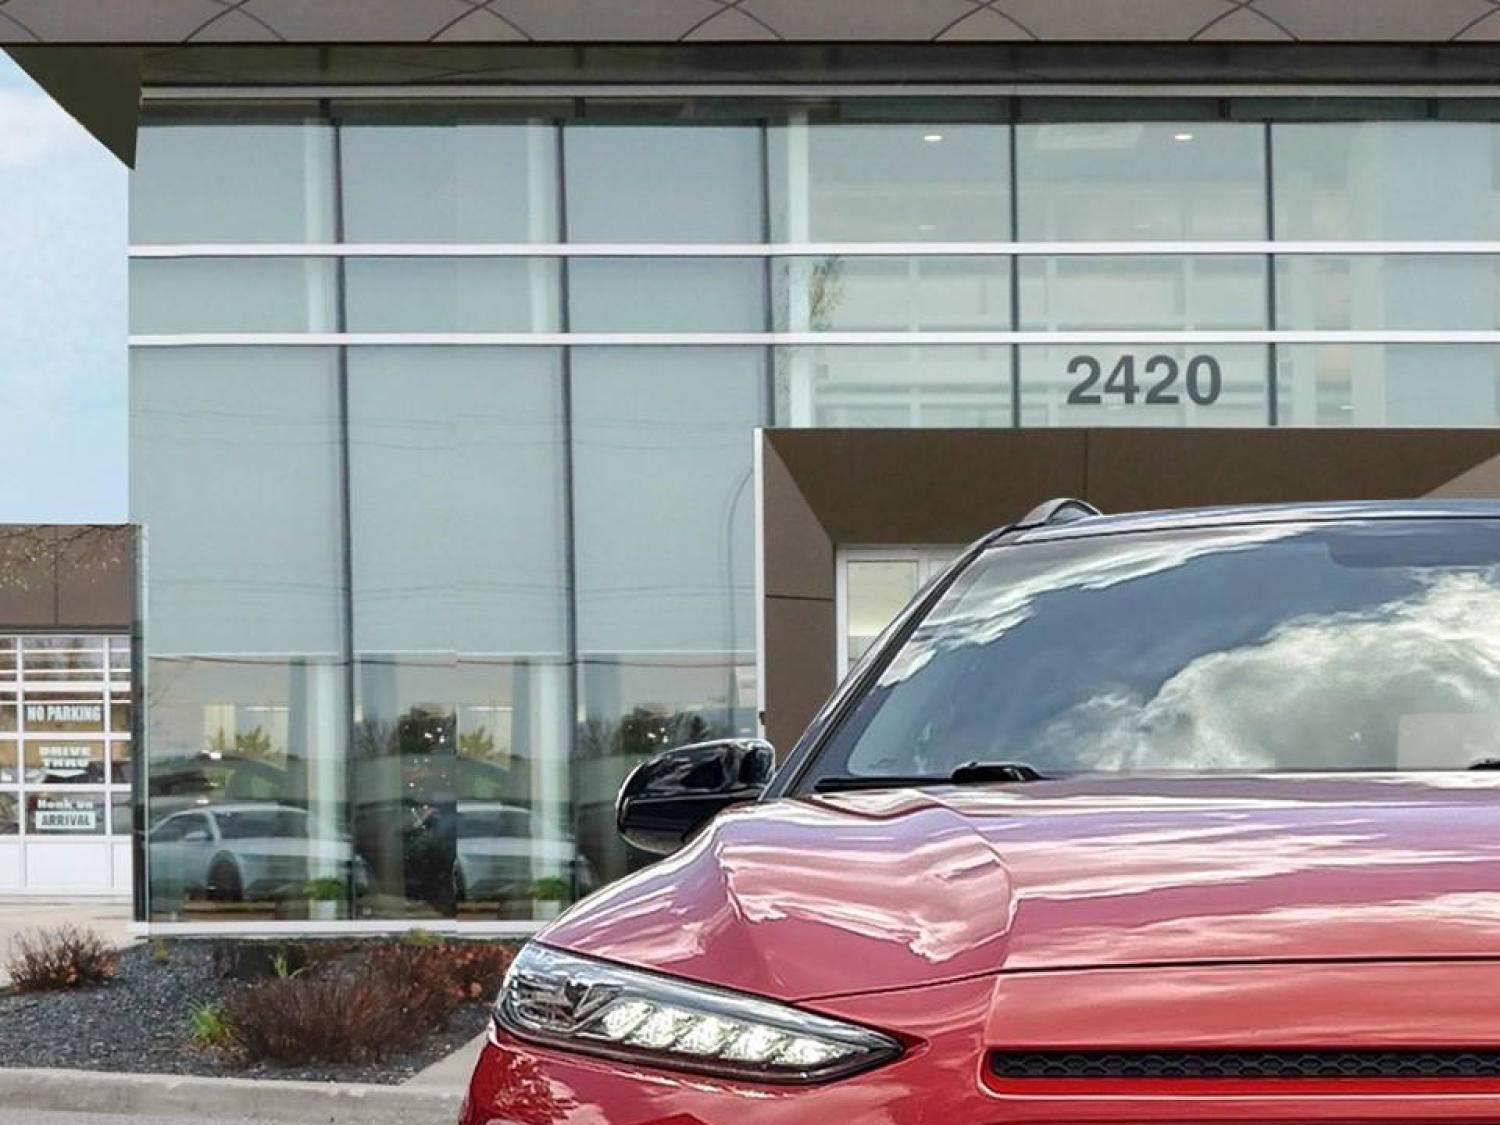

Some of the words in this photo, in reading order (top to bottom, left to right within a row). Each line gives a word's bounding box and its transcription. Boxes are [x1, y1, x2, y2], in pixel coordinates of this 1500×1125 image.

[1067, 355, 1221, 405] 2420
[27, 705, 45, 721] NO
[46, 705, 101, 721] PARKING
[41, 814, 91, 826] ARRIVAL
